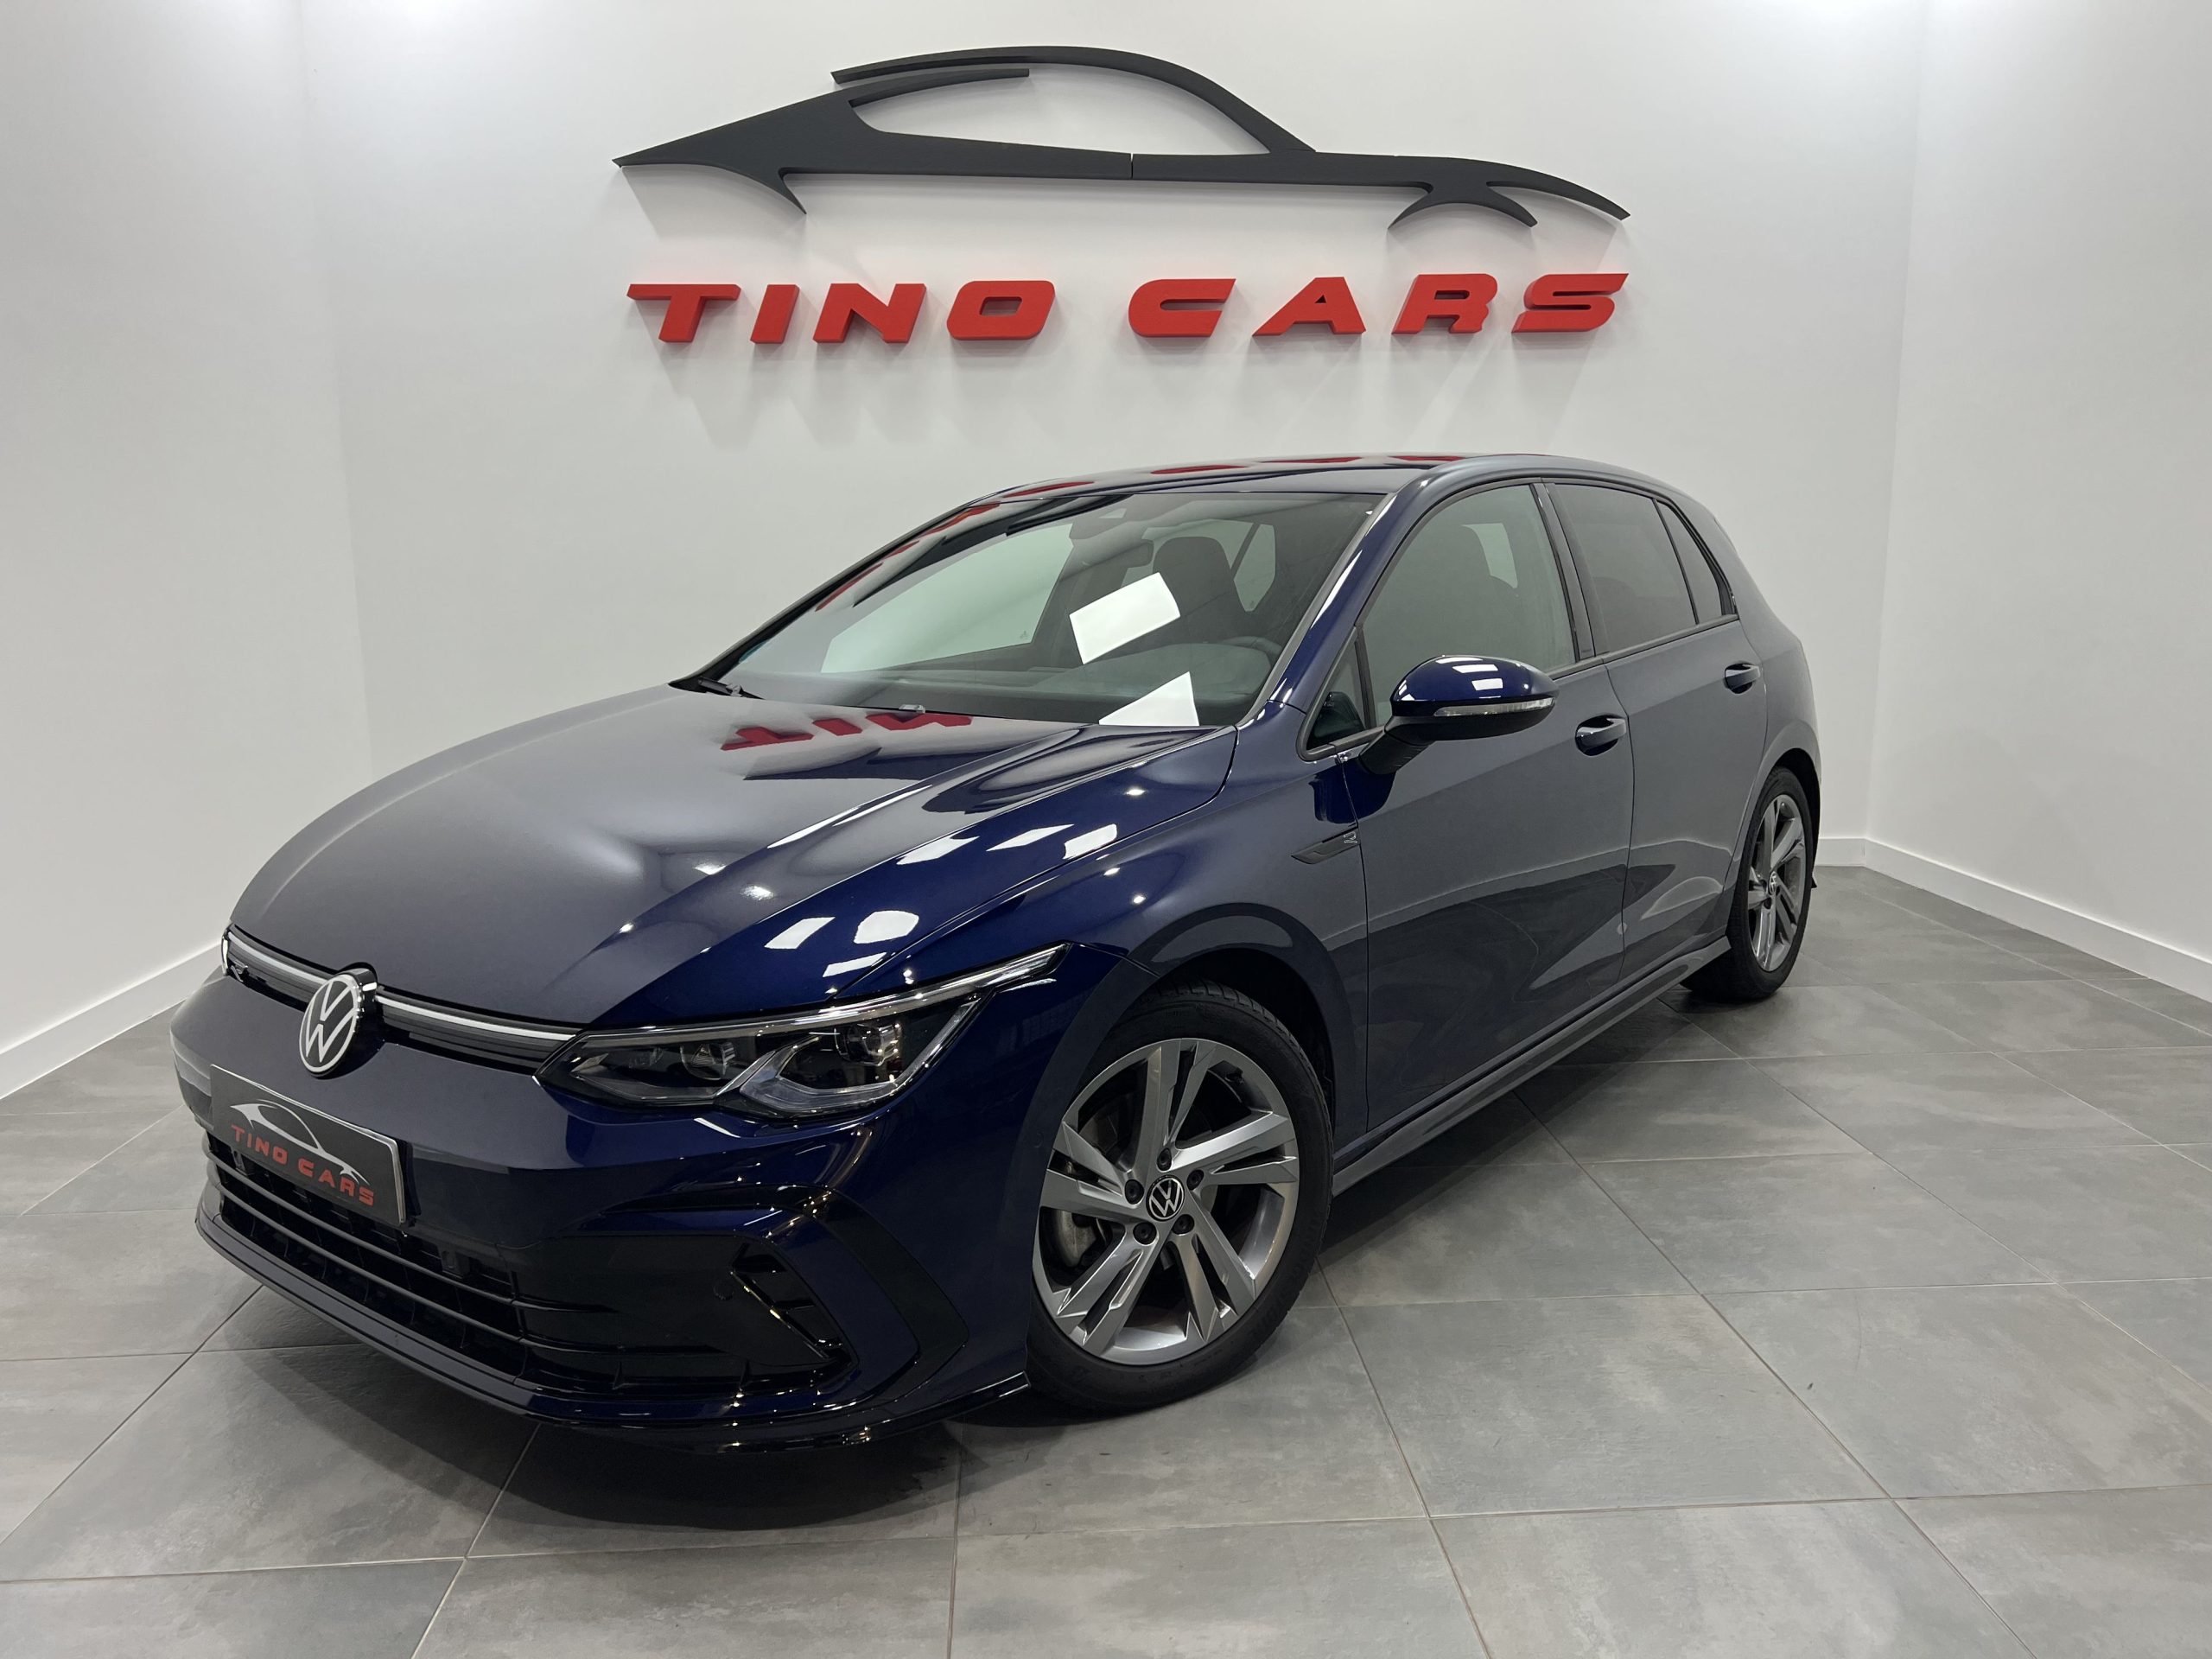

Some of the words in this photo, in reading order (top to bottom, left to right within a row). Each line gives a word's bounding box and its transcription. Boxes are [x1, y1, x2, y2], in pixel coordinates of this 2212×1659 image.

[626, 280, 1056, 344] TINO
[1128, 273, 1629, 338] CARS
[231, 1124, 289, 1166] TINO
[297, 1156, 375, 1207] CARS
